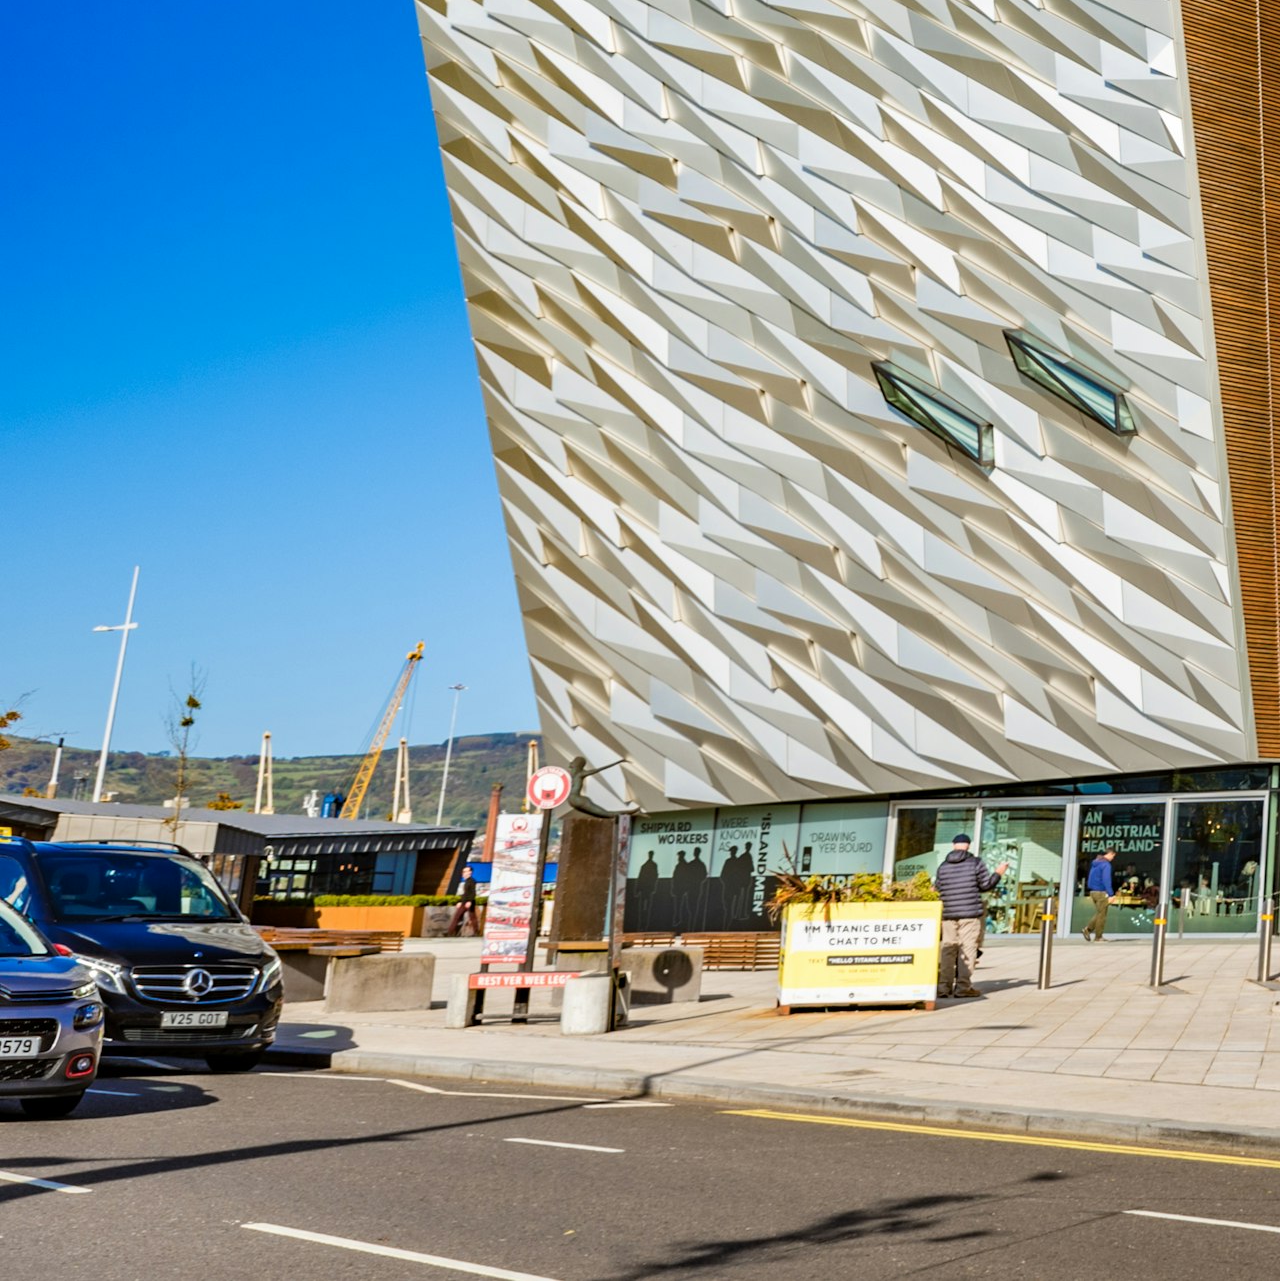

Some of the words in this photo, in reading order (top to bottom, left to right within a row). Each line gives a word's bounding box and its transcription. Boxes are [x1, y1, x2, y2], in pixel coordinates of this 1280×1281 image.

[721, 817, 749, 828] WERE
[1084, 811, 1104, 824] AN
[640, 821, 692, 833] SHIPYARD
[1082, 824, 1160, 838] INDUSTRIAL
[658, 833, 708, 844] WORKERS
[720, 829, 758, 840] KNOWN
[718, 841, 731, 852] AS
[819, 843, 837, 854] YER
[838, 842, 873, 853] BOURD
[1081, 838, 1155, 853] HEARTLAND
[825, 924, 870, 933] TITANIC
[874, 923, 923, 932] BELFAST
[828, 937, 859, 946] CHAT
[864, 937, 878, 945] TO
[882, 936, 902, 944] ME!
[477, 976, 502, 986] REST
[503, 975, 522, 985] YER
[524, 974, 546, 985] WEE
[170, 1013, 194, 1025] V25
[198, 1013, 221, 1025] GOT
[0, 1039, 32, 1053] 579
